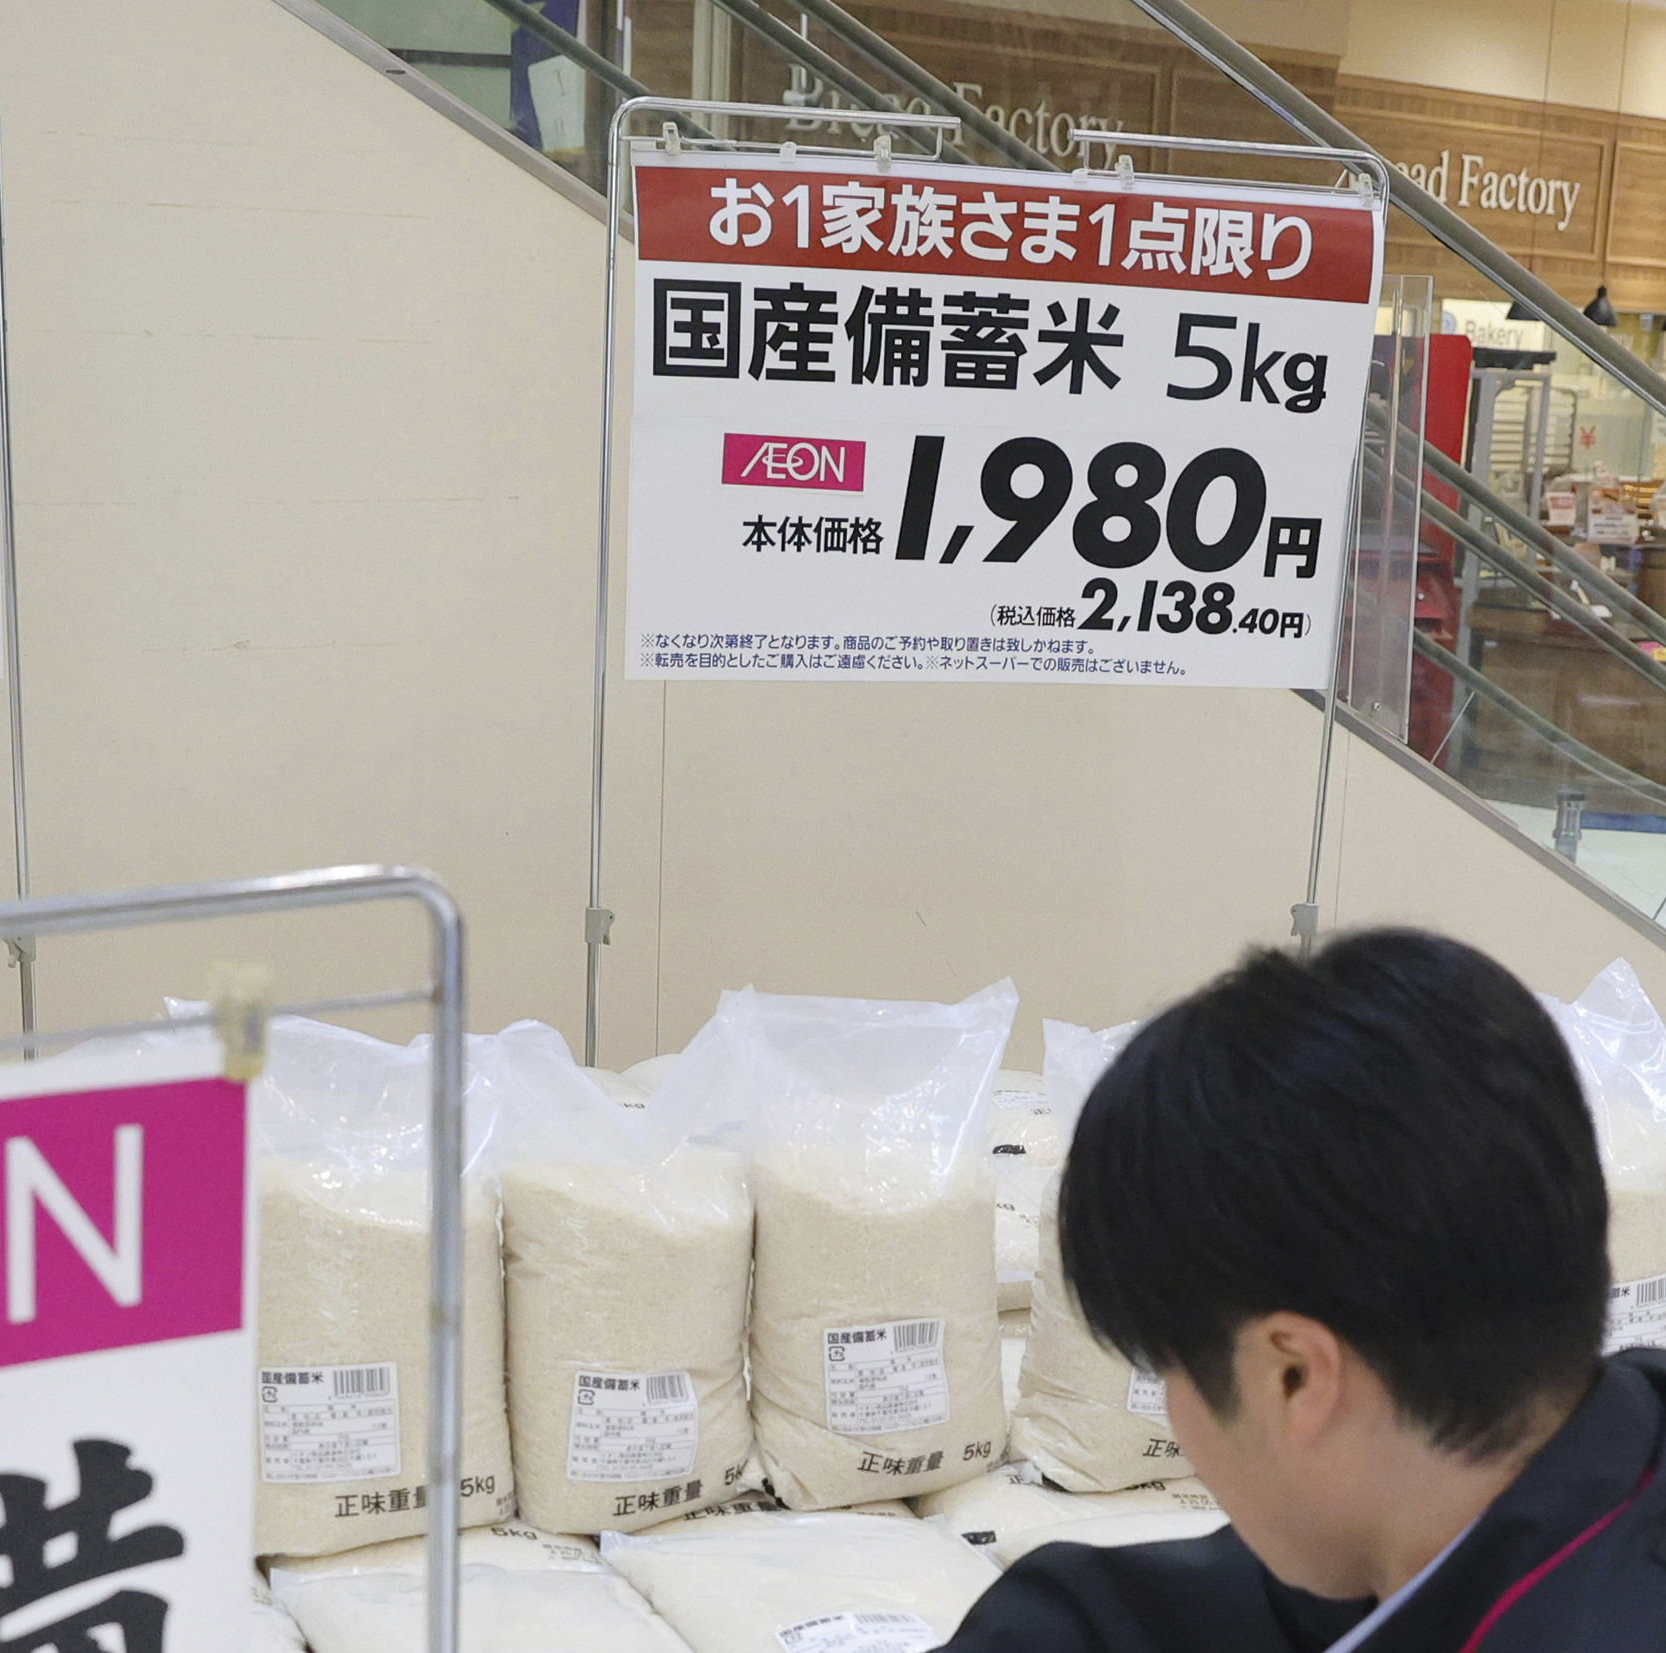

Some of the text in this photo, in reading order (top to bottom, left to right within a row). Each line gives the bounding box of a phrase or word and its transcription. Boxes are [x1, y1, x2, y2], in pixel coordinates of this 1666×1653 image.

[1459, 153, 1581, 231] Factory
[708, 177, 1313, 281] お1家族さま1点限り
[652, 278, 1329, 413] 国産備蓄米 5kg
[1465, 321, 1525, 347] Bakery
[742, 514, 883, 556] 本体価格
[857, 1439, 992, 1477] 正味重量 5kg
[460, 1474, 496, 1498] 5kg
